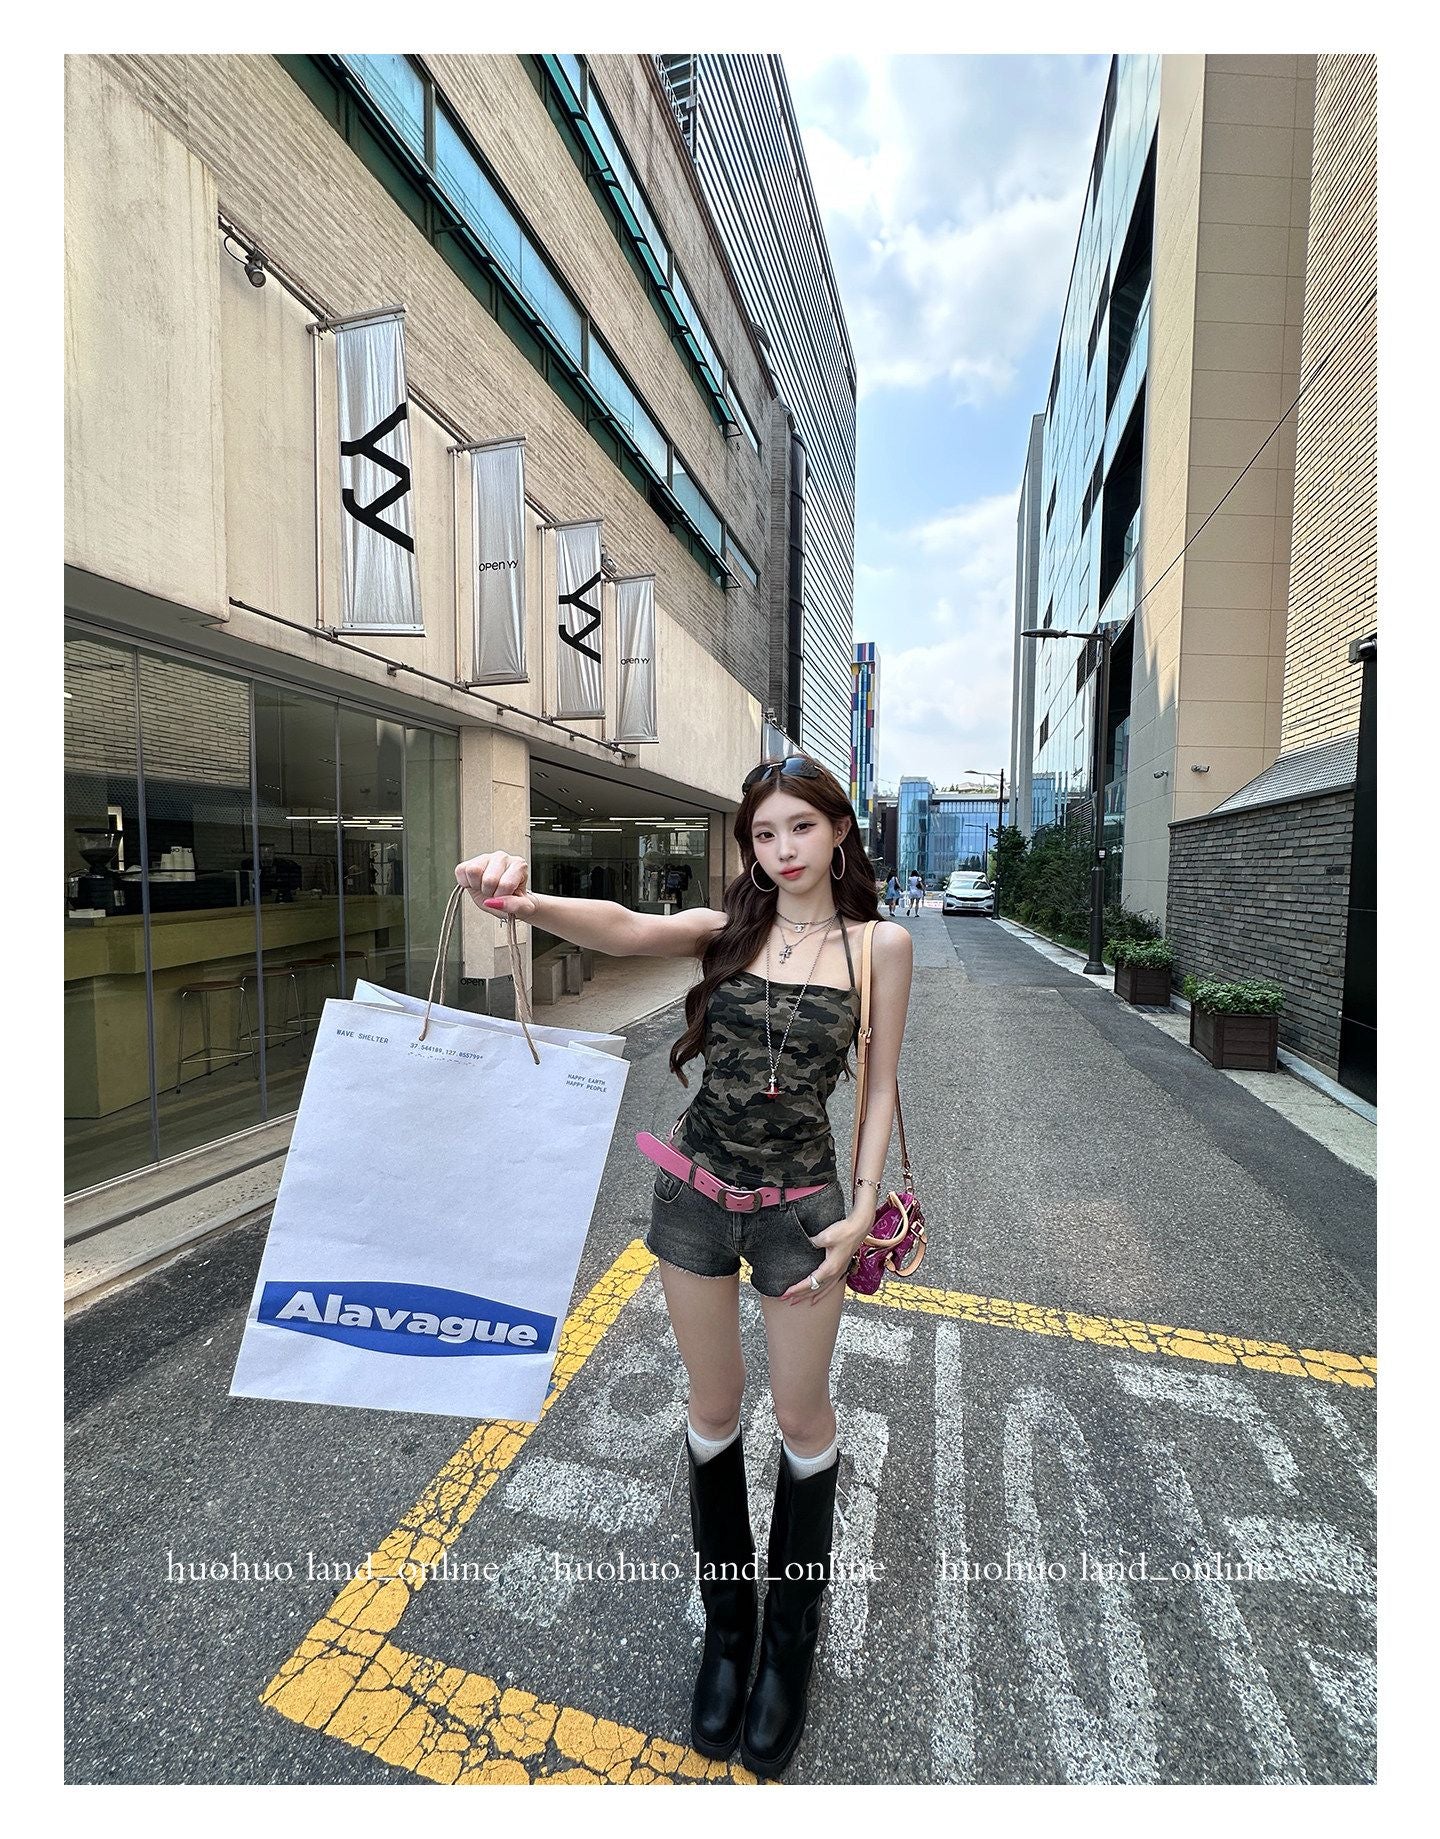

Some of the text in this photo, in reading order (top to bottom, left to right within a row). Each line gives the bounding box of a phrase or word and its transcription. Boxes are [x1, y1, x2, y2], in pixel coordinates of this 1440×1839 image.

[336, 1029, 389, 1044] WAVE SHELTER
[587, 1077, 606, 1085] EARTH
[585, 1083, 608, 1093] PEOPLE
[275, 1290, 539, 1346] Alavague
